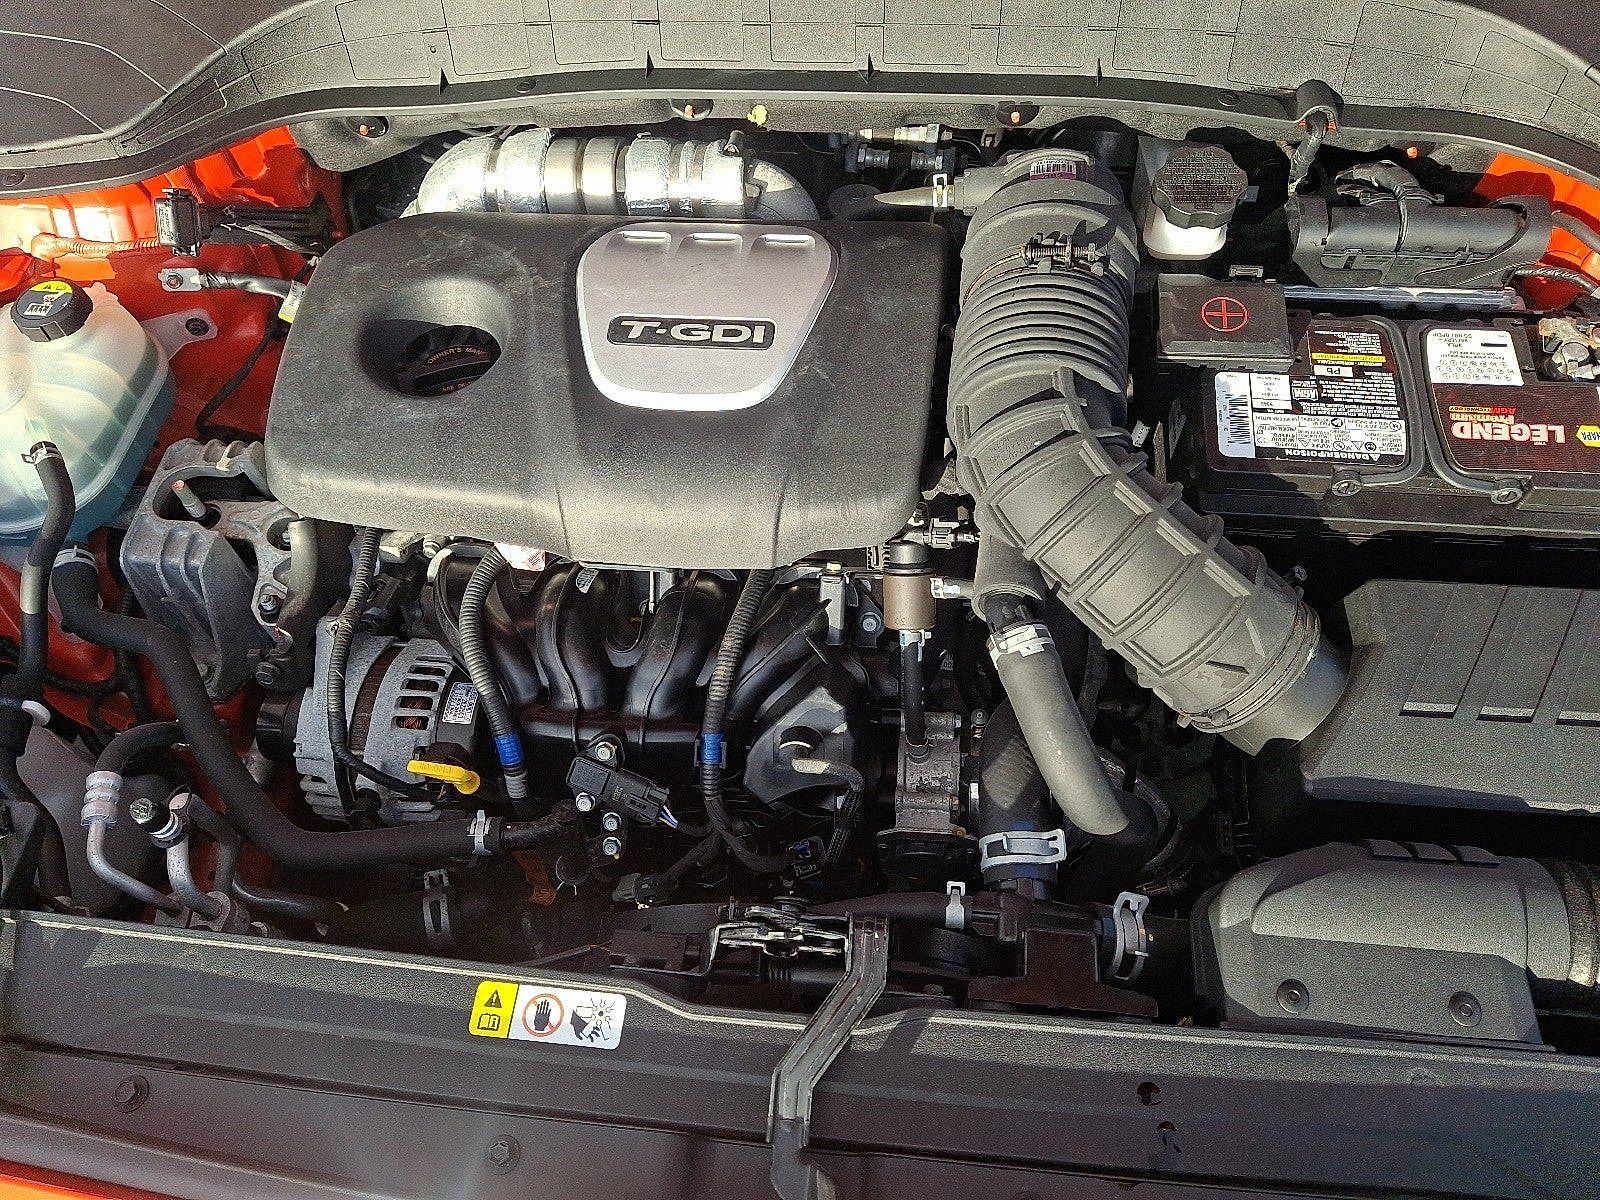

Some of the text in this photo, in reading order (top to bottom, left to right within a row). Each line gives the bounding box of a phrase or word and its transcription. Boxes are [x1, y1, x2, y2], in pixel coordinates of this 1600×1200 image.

[427, 347, 462, 364] OWNER'S
[1326, 367, 1341, 375] Pb
[1491, 406, 1516, 415] AGM
[1449, 413, 1515, 425] Premium
[1451, 422, 1566, 444] LEGEND
[1284, 449, 1370, 460] DANGER/POISON
